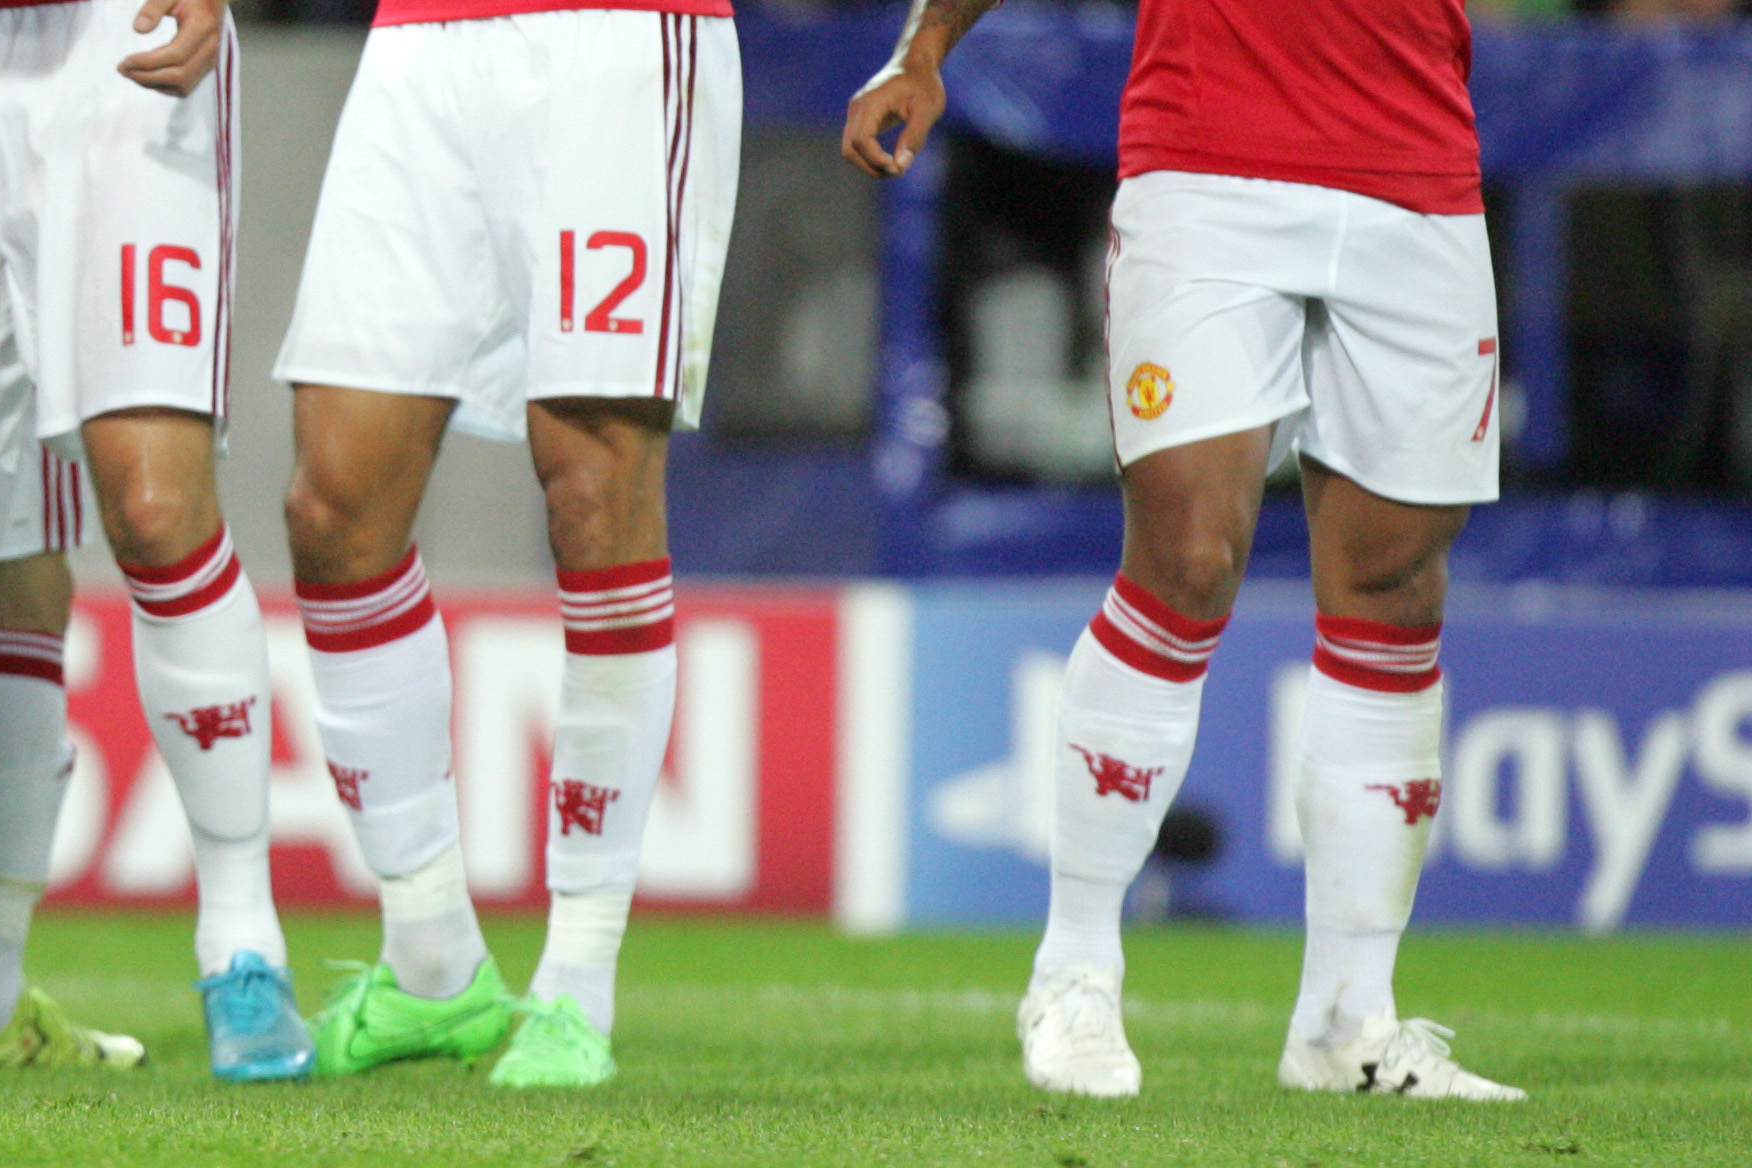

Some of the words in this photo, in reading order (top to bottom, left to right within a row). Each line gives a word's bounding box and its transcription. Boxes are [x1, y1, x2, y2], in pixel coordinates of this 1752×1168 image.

[119, 242, 203, 348] 16
[559, 228, 649, 335] 12
[1471, 337, 1497, 442] 7
